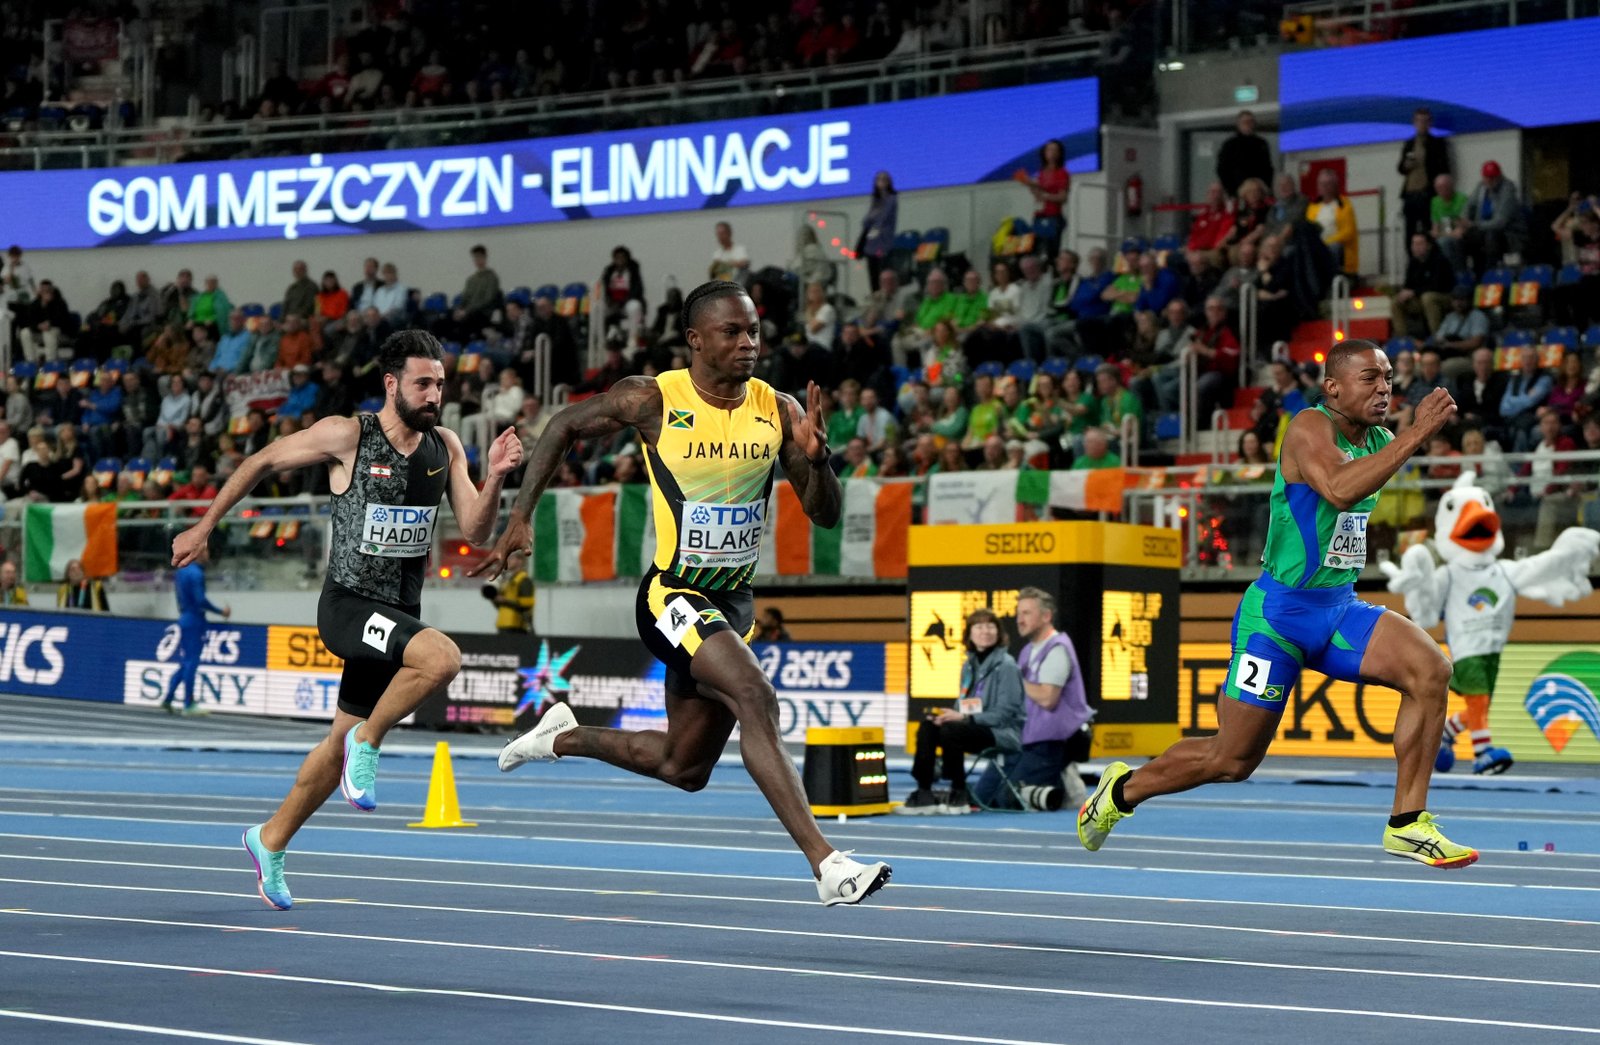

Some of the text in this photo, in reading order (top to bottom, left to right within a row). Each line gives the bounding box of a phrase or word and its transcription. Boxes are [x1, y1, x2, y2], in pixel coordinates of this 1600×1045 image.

[87, 173, 207, 236] 60M
[218, 153, 513, 239] MĘŻCZYZN
[551, 121, 850, 208] ELIMINACJE
[683, 442, 770, 459] JAMAICA
[388, 508, 432, 524] TDK
[711, 503, 761, 525] TDK
[370, 525, 427, 543] HADID
[688, 527, 761, 549] BLAKE
[985, 532, 1055, 554] SEIKO
[671, 607, 687, 631] 4
[368, 624, 385, 641] 3
[1243, 660, 1259, 688] 2
[141, 667, 255, 705] SNY
